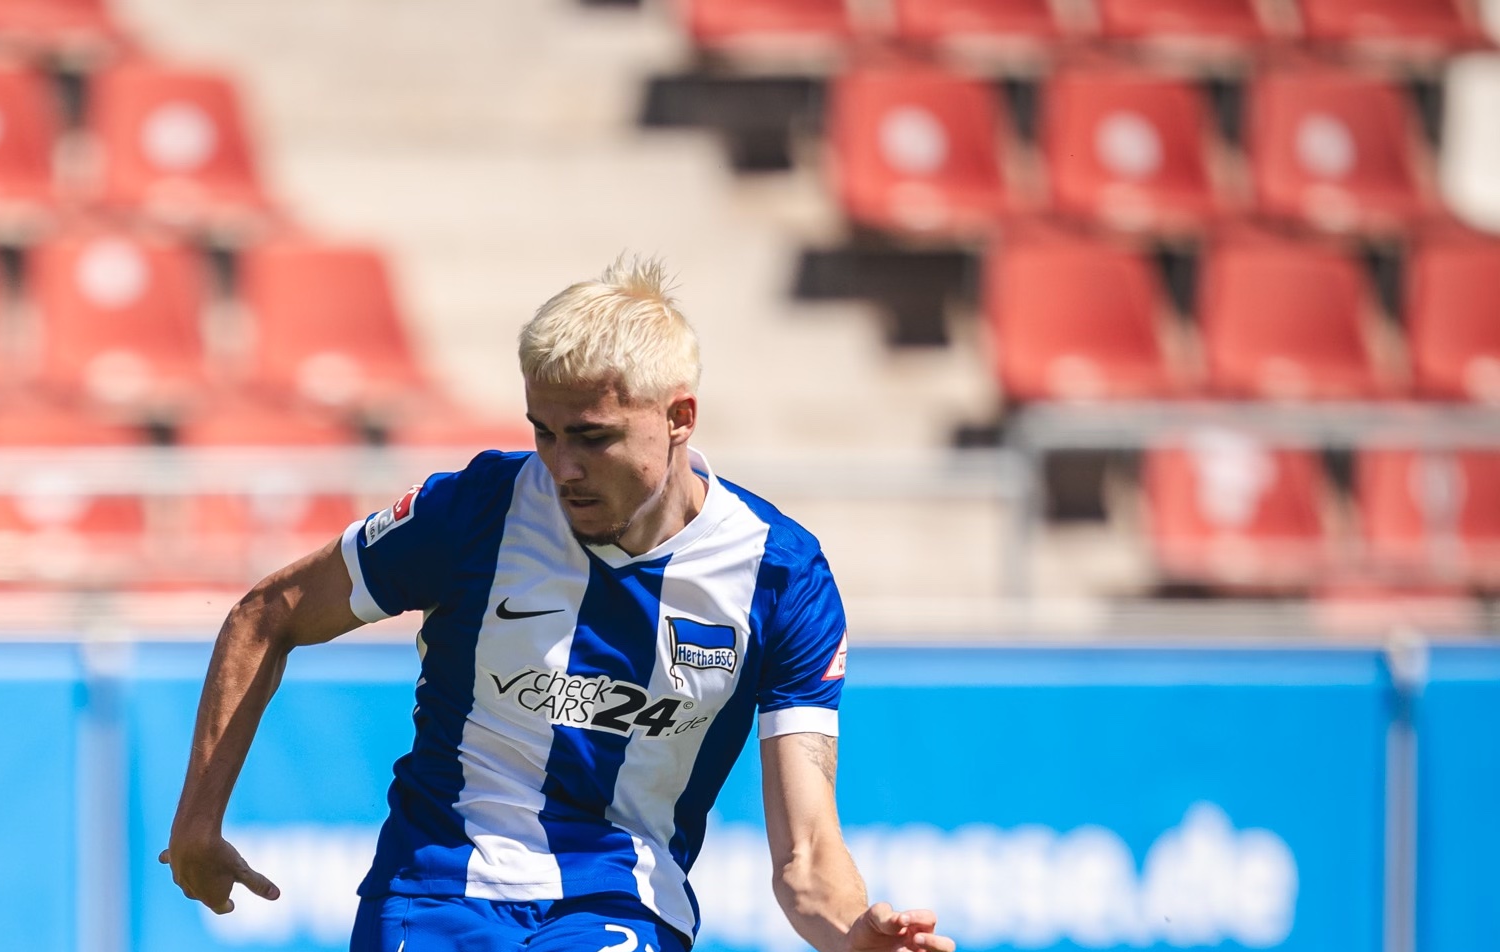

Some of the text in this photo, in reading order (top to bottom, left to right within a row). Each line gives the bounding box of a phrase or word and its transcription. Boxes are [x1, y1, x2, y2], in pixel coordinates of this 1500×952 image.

[677, 645, 734, 667] Hertha BSC
[533, 670, 611, 703] check
[517, 688, 596, 724] CARS
